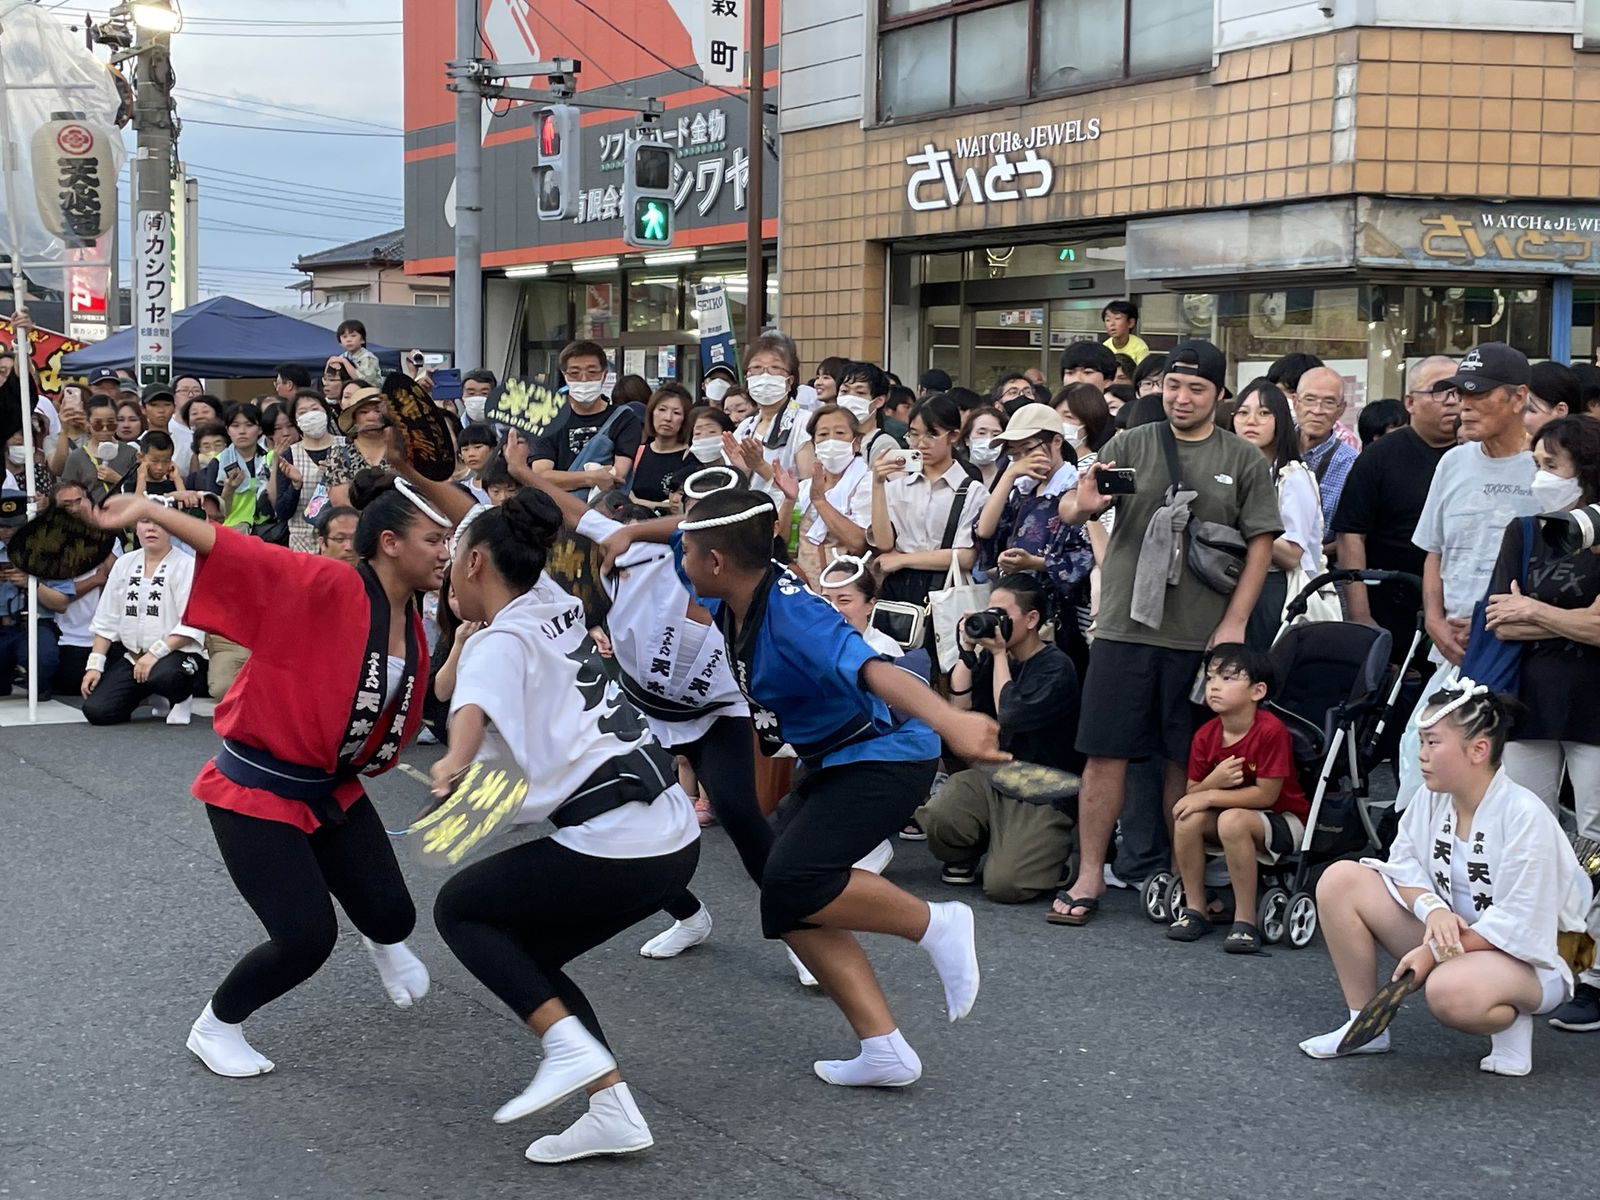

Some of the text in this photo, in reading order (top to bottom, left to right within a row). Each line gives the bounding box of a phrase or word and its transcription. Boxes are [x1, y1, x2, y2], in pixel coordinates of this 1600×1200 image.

[906, 144, 1053, 211] さいとう
[1420, 214, 1592, 260] さいとう
[697, 296, 724, 312] SEIKO
